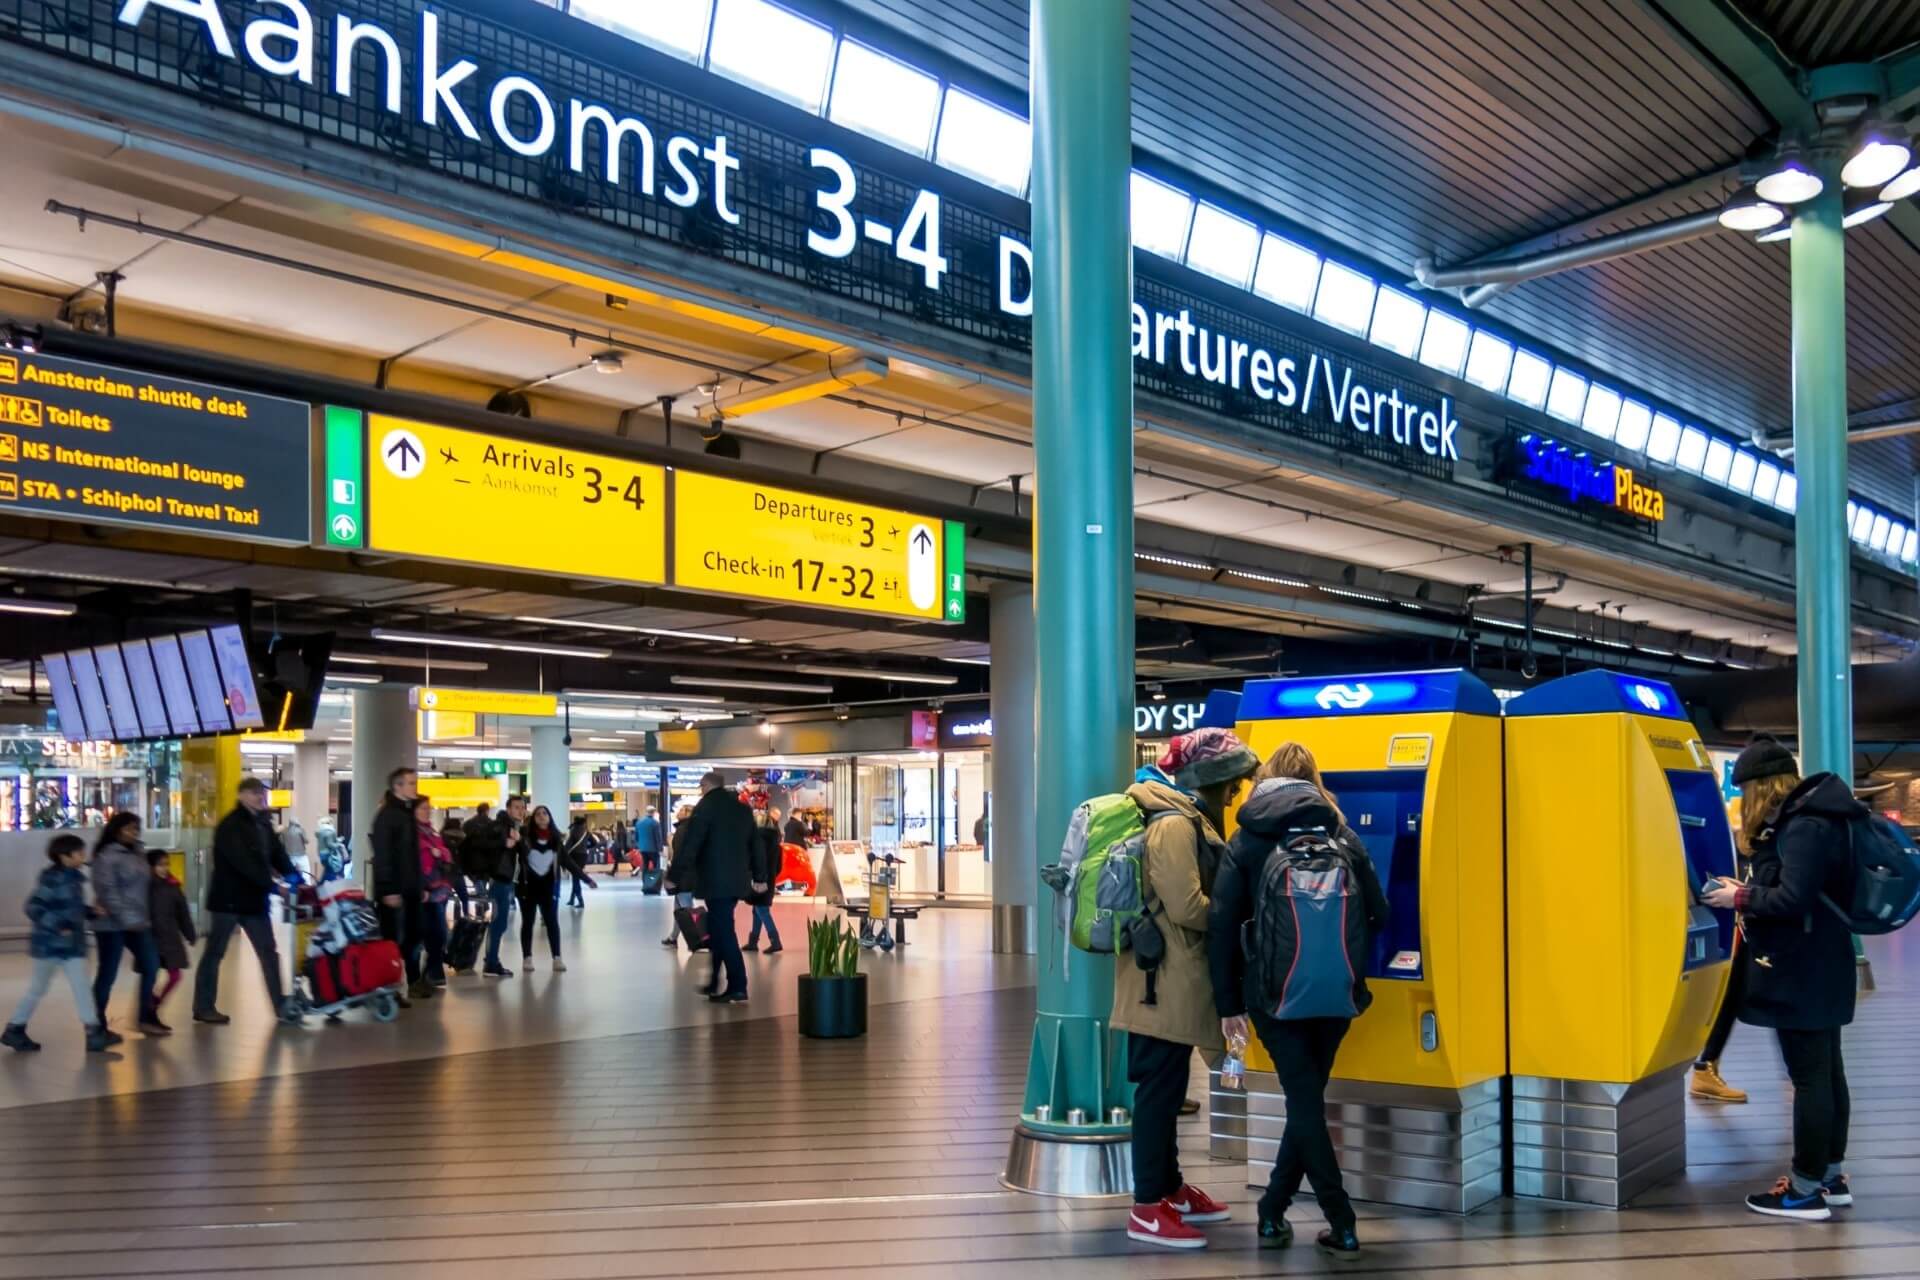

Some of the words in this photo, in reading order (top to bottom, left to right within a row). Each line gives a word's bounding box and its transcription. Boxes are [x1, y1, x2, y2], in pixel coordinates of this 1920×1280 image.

[807, 147, 947, 290] 3-4
[22, 364, 134, 399] Amsterdam
[139, 385, 202, 410] shuttle
[207, 397, 248, 418] desk
[46, 406, 112, 432] Toilets
[0, 480, 14, 492] TA
[22, 441, 50, 461] NS
[56, 446, 179, 479] International
[183, 464, 245, 490] lounge
[483, 444, 575, 478] Arrivals
[583, 467, 645, 510] 3-4
[22, 480, 61, 500] STA
[82, 488, 163, 513] Schiphol
[166, 498, 220, 521] Travel
[225, 506, 259, 526] Taxi
[1614, 466, 1664, 521] Plaza
[754, 492, 853, 527] Departures
[860, 516, 875, 548] 3
[703, 551, 785, 579] Check-in
[792, 558, 875, 600] 17-32
[1135, 706, 1167, 732] DY
[1172, 703, 1206, 730] SH
